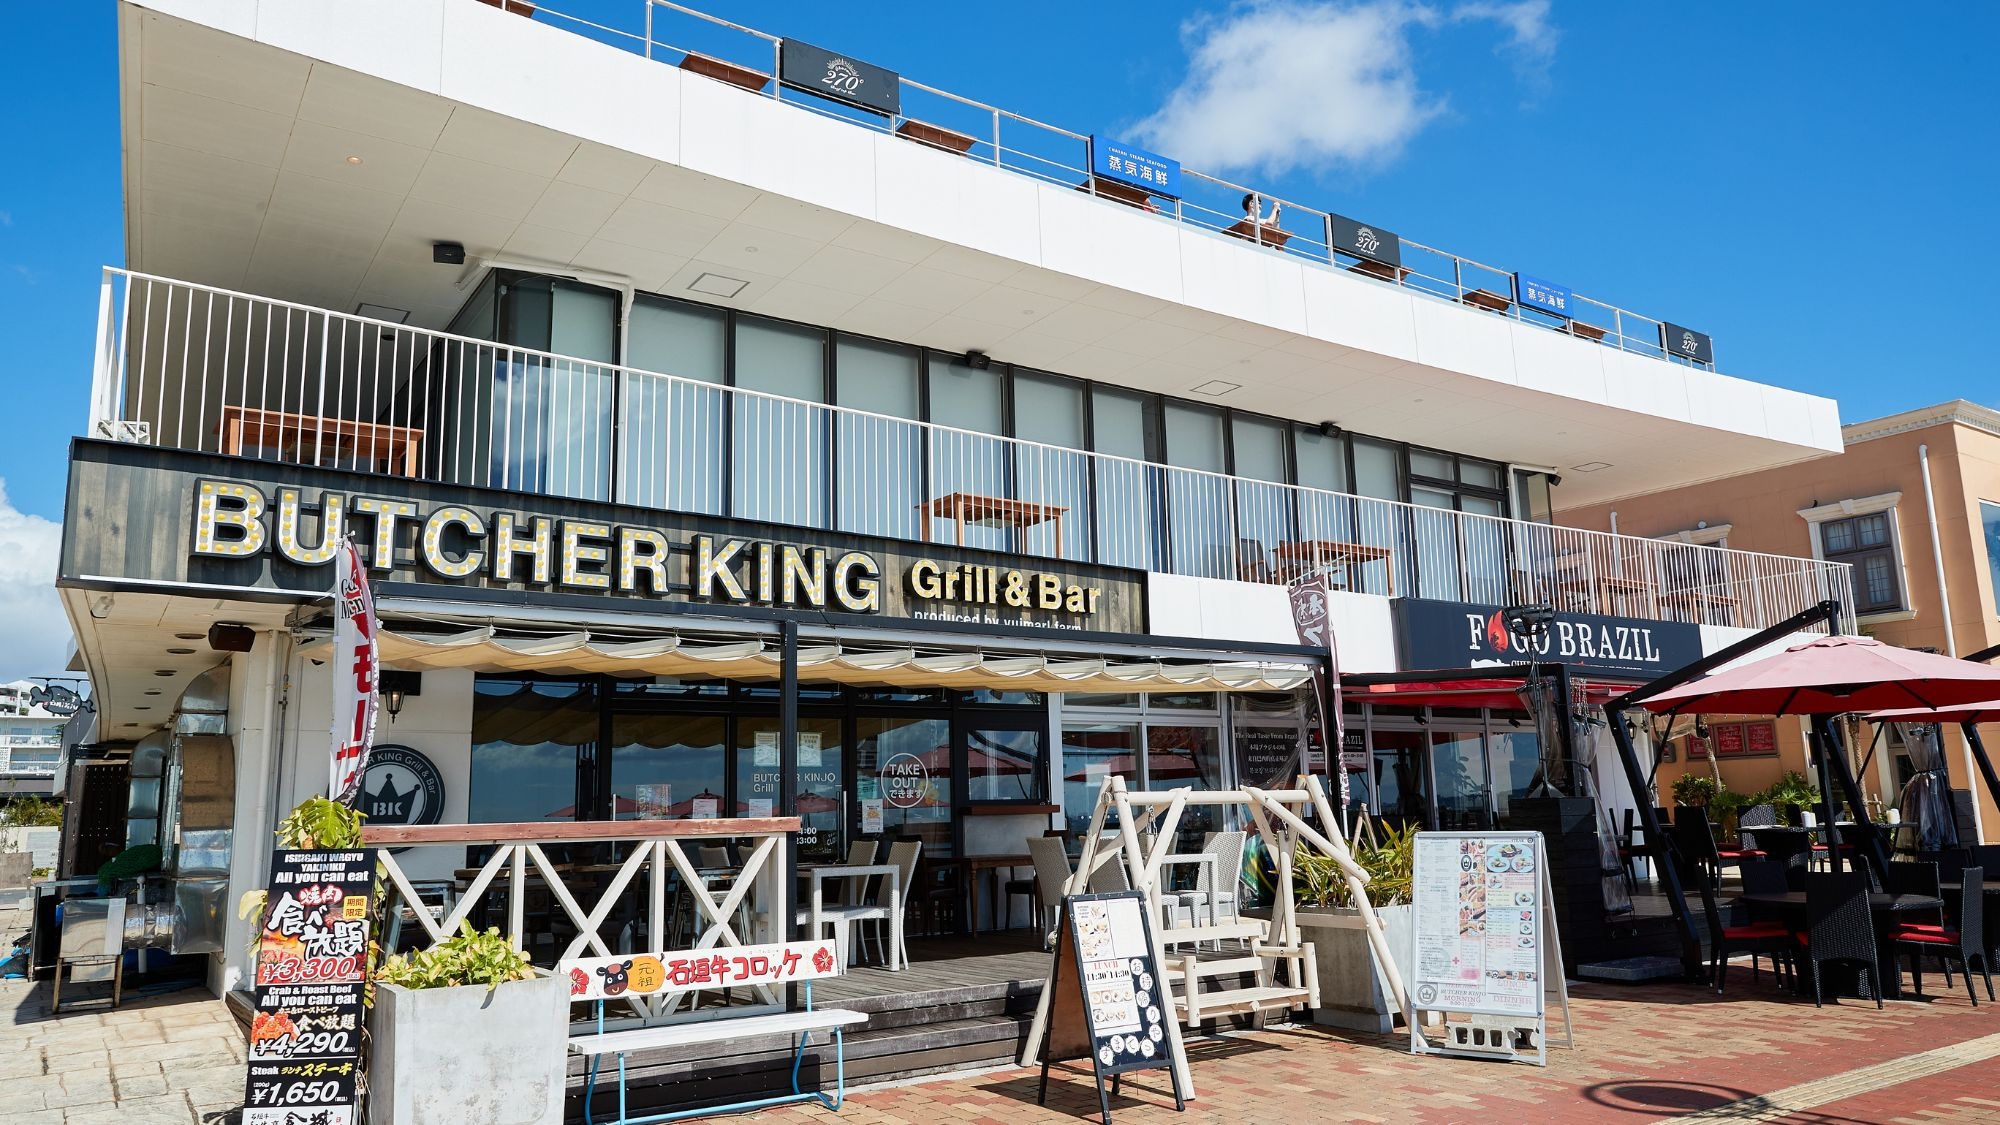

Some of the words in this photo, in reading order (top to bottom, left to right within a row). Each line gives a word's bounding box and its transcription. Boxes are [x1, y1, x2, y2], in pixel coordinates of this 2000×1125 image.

[1129, 153, 1145, 162] STEAM
[1146, 159, 1168, 169] SEAFOOD
[1108, 155, 1168, 186] 蒸気海鮮
[190, 477, 670, 595] BUTCHER
[692, 534, 882, 614] KING
[911, 558, 998, 604] Grill
[1004, 569, 1032, 608] &
[1038, 573, 1101, 614] Bar
[914, 610, 981, 625] produced
[984, 613, 1000, 625] by
[1556, 621, 1660, 662] BRAZIL
[377, 752, 403, 762] KING
[404, 756, 424, 772] Grill
[426, 777, 436, 794] Bar
[889, 763, 920, 776] TAKE
[804, 772, 836, 783] KINJO
[892, 777, 918, 789] OUT
[753, 783, 774, 793] Grill
[889, 789, 923, 799] できます
[372, 802, 403, 816] BK
[284, 853, 327, 863] ISHIGAKI
[328, 852, 364, 862] WAGYU
[301, 863, 346, 872] YAKINIKU
[275, 872, 293, 883] All
[295, 873, 319, 884] you
[321, 872, 345, 882] can
[347, 871, 369, 881] eat
[299, 885, 342, 904] 焼肉
[268, 891, 328, 935] 食べ
[345, 908, 364, 917] 限定
[264, 957, 356, 983] ¥3,300
[638, 962, 654, 987] 元祖
[666, 949, 802, 985] 石垣牛コロッケ
[269, 986, 292, 995] Crab
[301, 986, 328, 994] Roast
[329, 985, 352, 993] Beef
[261, 995, 279, 1006] All
[281, 995, 306, 1007] you
[307, 994, 333, 1005] can
[335, 993, 357, 1004] eat
[1444, 995, 1481, 1003] MORNING
[296, 1013, 356, 1031] 食べ放題
[256, 1031, 349, 1057] ¥4,290
[251, 1066, 279, 1075] Steak
[251, 1080, 340, 1107] ¥1,650
